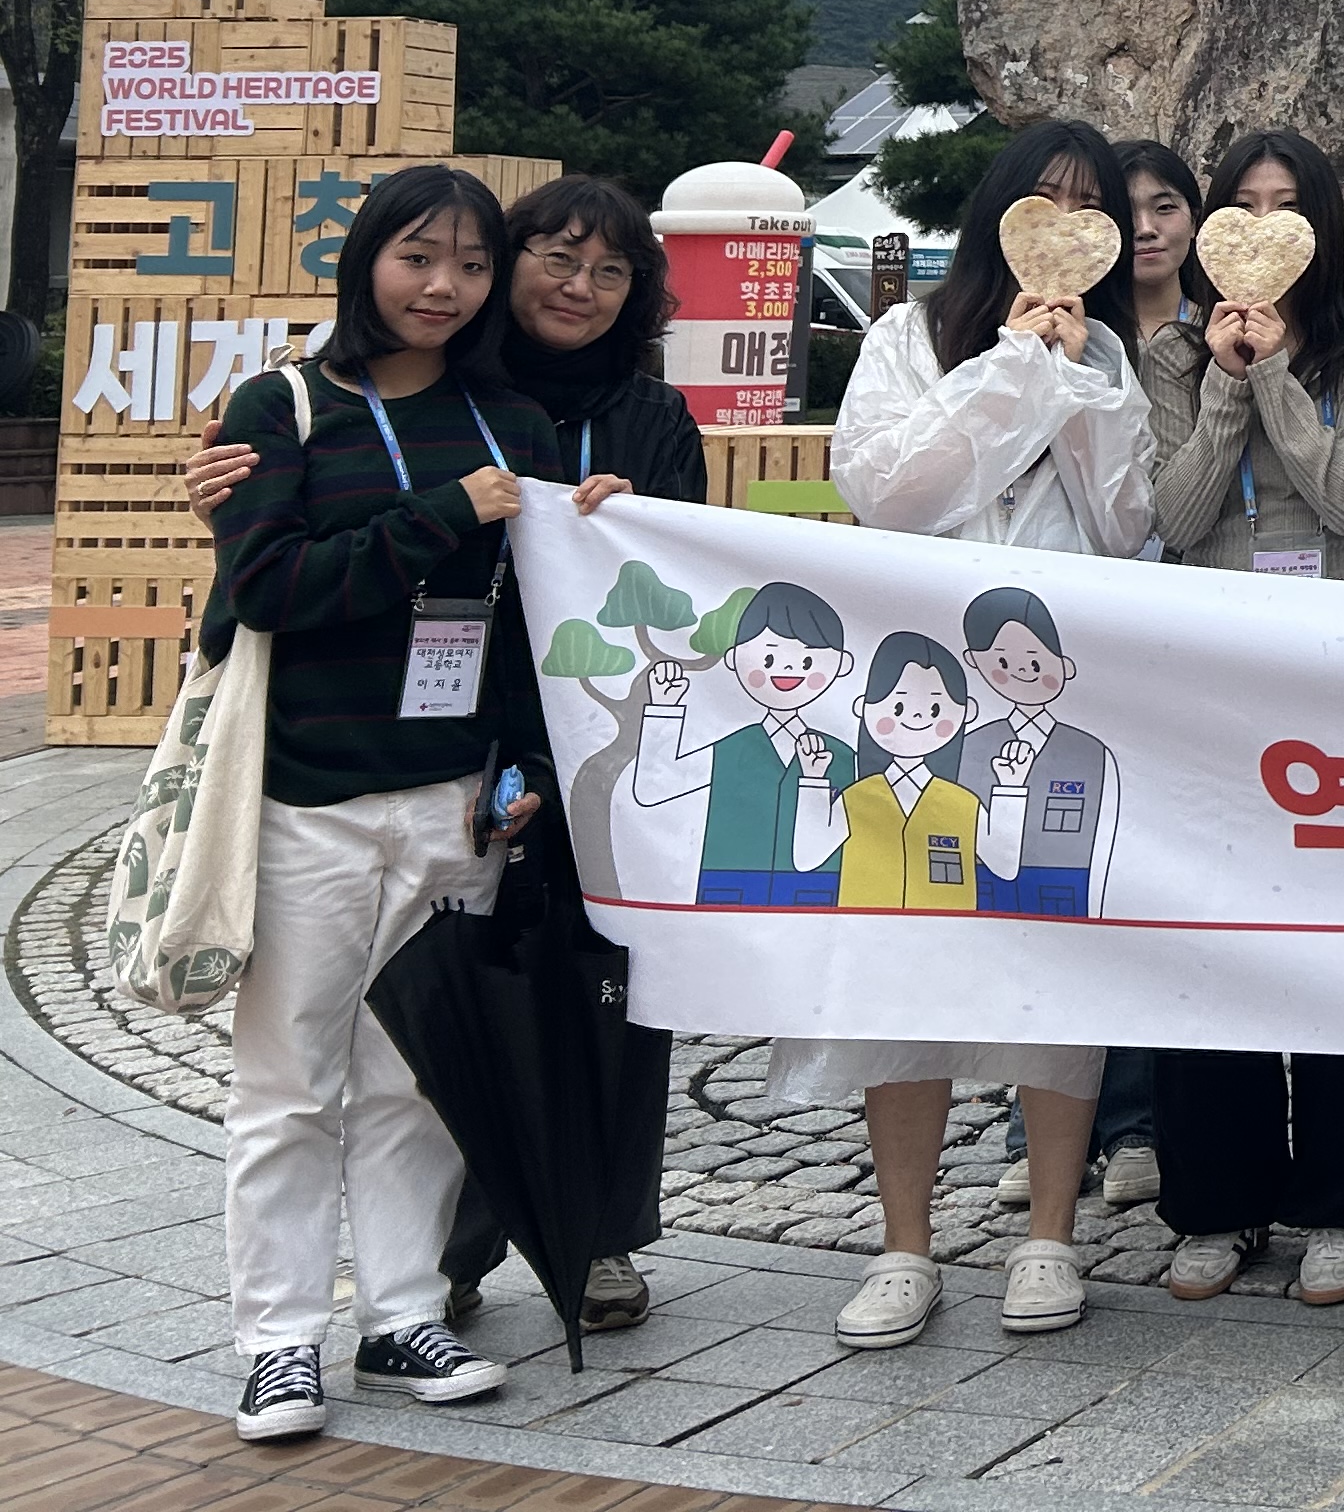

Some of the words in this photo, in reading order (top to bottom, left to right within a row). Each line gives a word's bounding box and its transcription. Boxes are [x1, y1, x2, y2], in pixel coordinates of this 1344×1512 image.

[108, 46, 186, 69] 2025
[107, 76, 217, 100] WORLD
[222, 75, 376, 100] HERITAGE
[105, 108, 250, 132] FESTIVAL
[748, 215, 790, 232] Take
[792, 219, 812, 233] out
[747, 260, 793, 279] 2,500
[744, 300, 790, 319] 3,000
[721, 330, 791, 377] 매점
[72, 317, 337, 422] 세계
[1052, 781, 1083, 793] RCY
[930, 836, 958, 848] RCY
